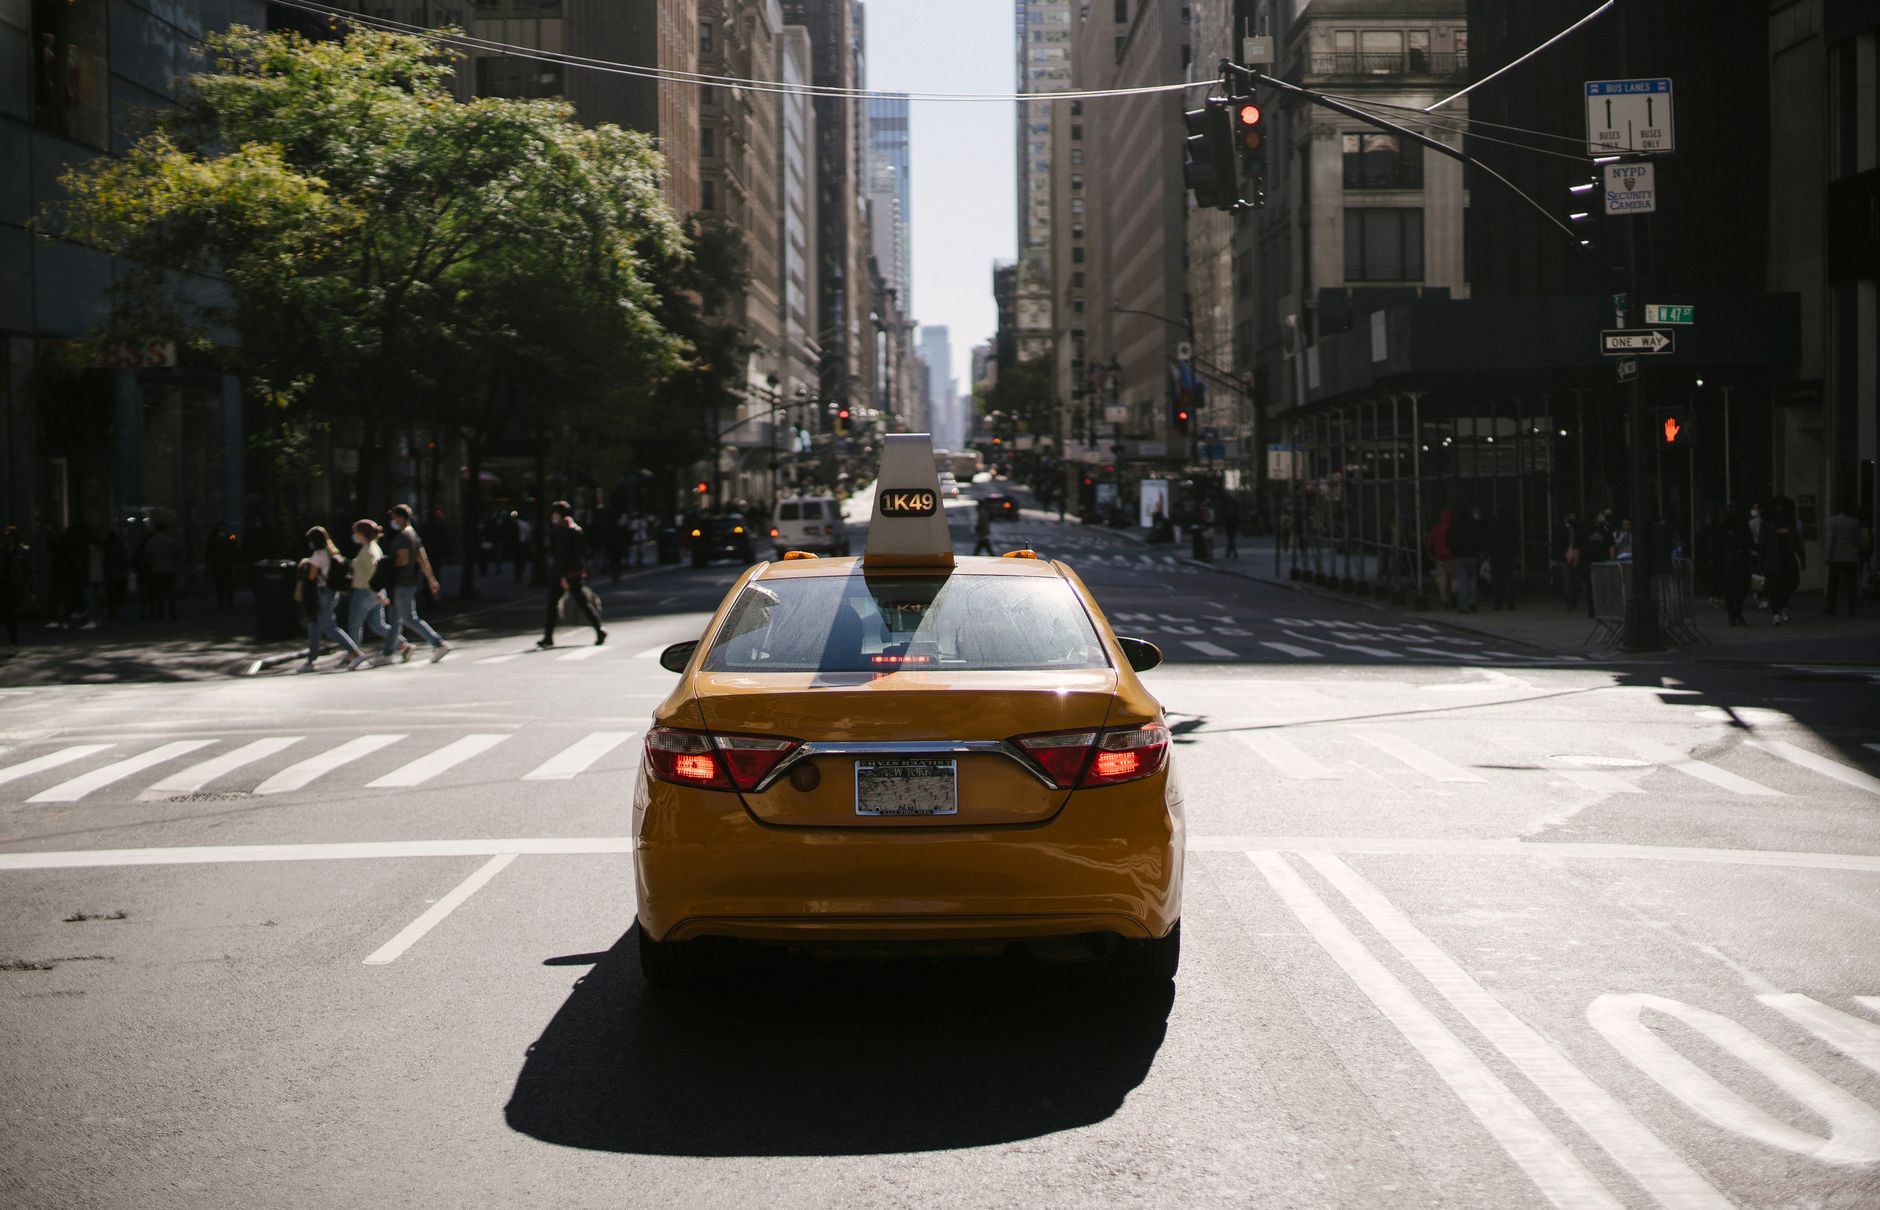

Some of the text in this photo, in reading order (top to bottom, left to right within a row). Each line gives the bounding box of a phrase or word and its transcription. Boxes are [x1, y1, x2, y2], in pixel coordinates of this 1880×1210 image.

[1605, 82, 1651, 93] BUS LANES
[1599, 130, 1621, 140] BUSES
[1640, 128, 1662, 138] BUSES
[1601, 141, 1620, 150] ONLY
[1642, 139, 1661, 149] ONLY
[1612, 166, 1646, 178] NYPD
[1606, 191, 1652, 201] SECURITY
[1609, 200, 1652, 211] CAMERA
[1660, 307, 1668, 321] W
[1670, 307, 1682, 322] 47
[1611, 336, 1663, 347] ONE WAY
[882, 492, 934, 512] 1K49
